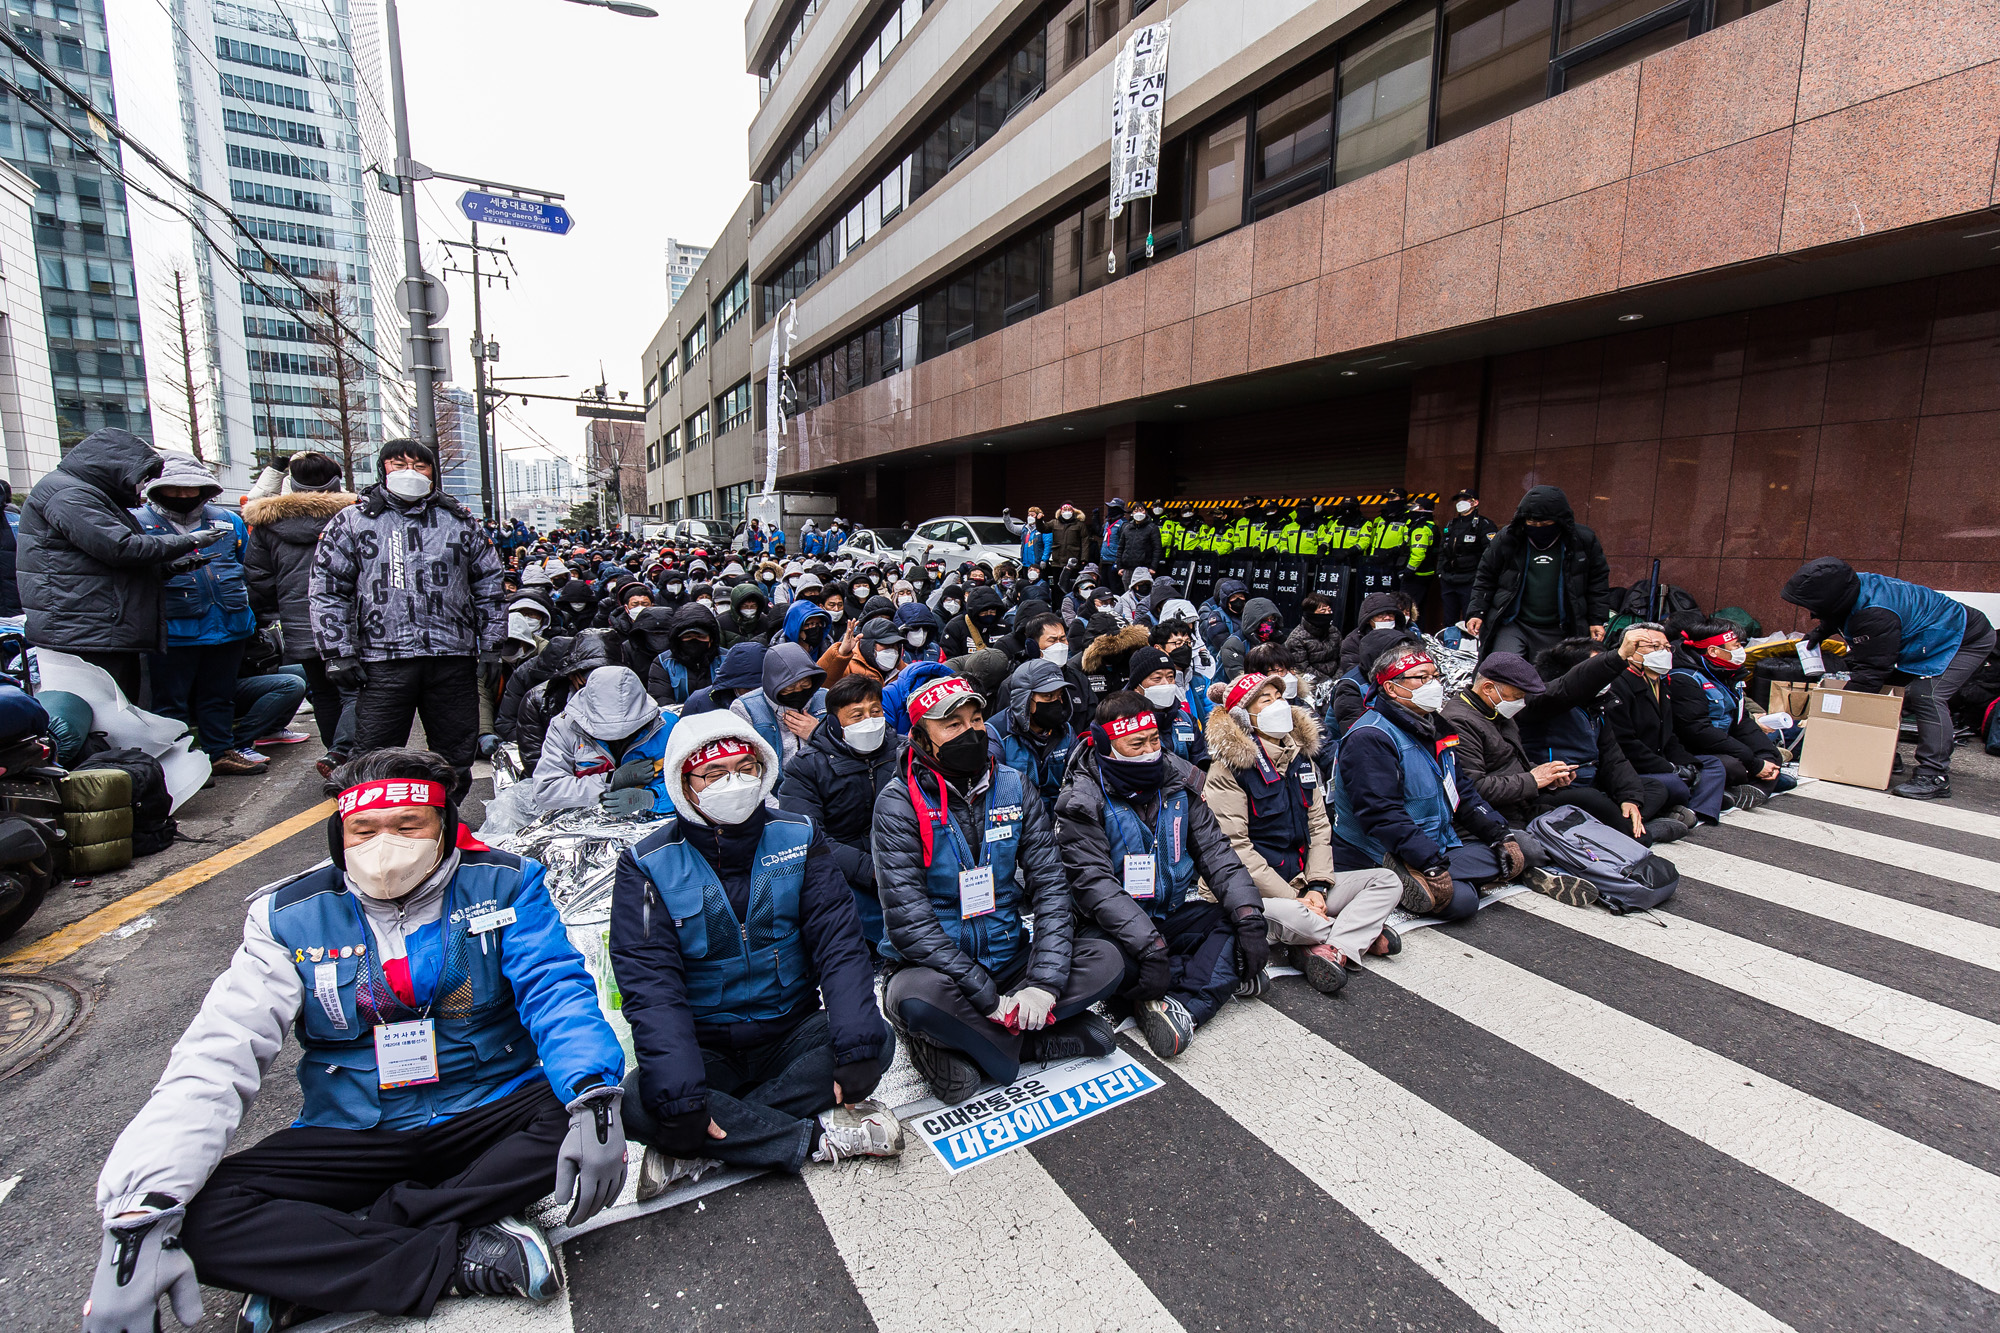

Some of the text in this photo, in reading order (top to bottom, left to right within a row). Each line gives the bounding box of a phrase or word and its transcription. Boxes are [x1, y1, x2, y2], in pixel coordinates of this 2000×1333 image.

[468, 202, 478, 210] 47
[490, 197, 543, 215] 세종대로9길
[483, 206, 550, 224] Sejong-daero 9-gil
[554, 216, 564, 224] 51
[1254, 568, 1271, 579] 경찰
[1278, 570, 1299, 581] 경찰
[1318, 572, 1340, 583] 경찰
[1364, 575, 1393, 587] 경찰
[1277, 585, 1297, 594] POLICE
[1316, 589, 1337, 598] POLICE
[919, 684, 950, 709] 단결
[385, 782, 430, 804] 투쟁
[383, 1029, 426, 1041] 선거사무원
[922, 1079, 1050, 1136] CJ대한통운은
